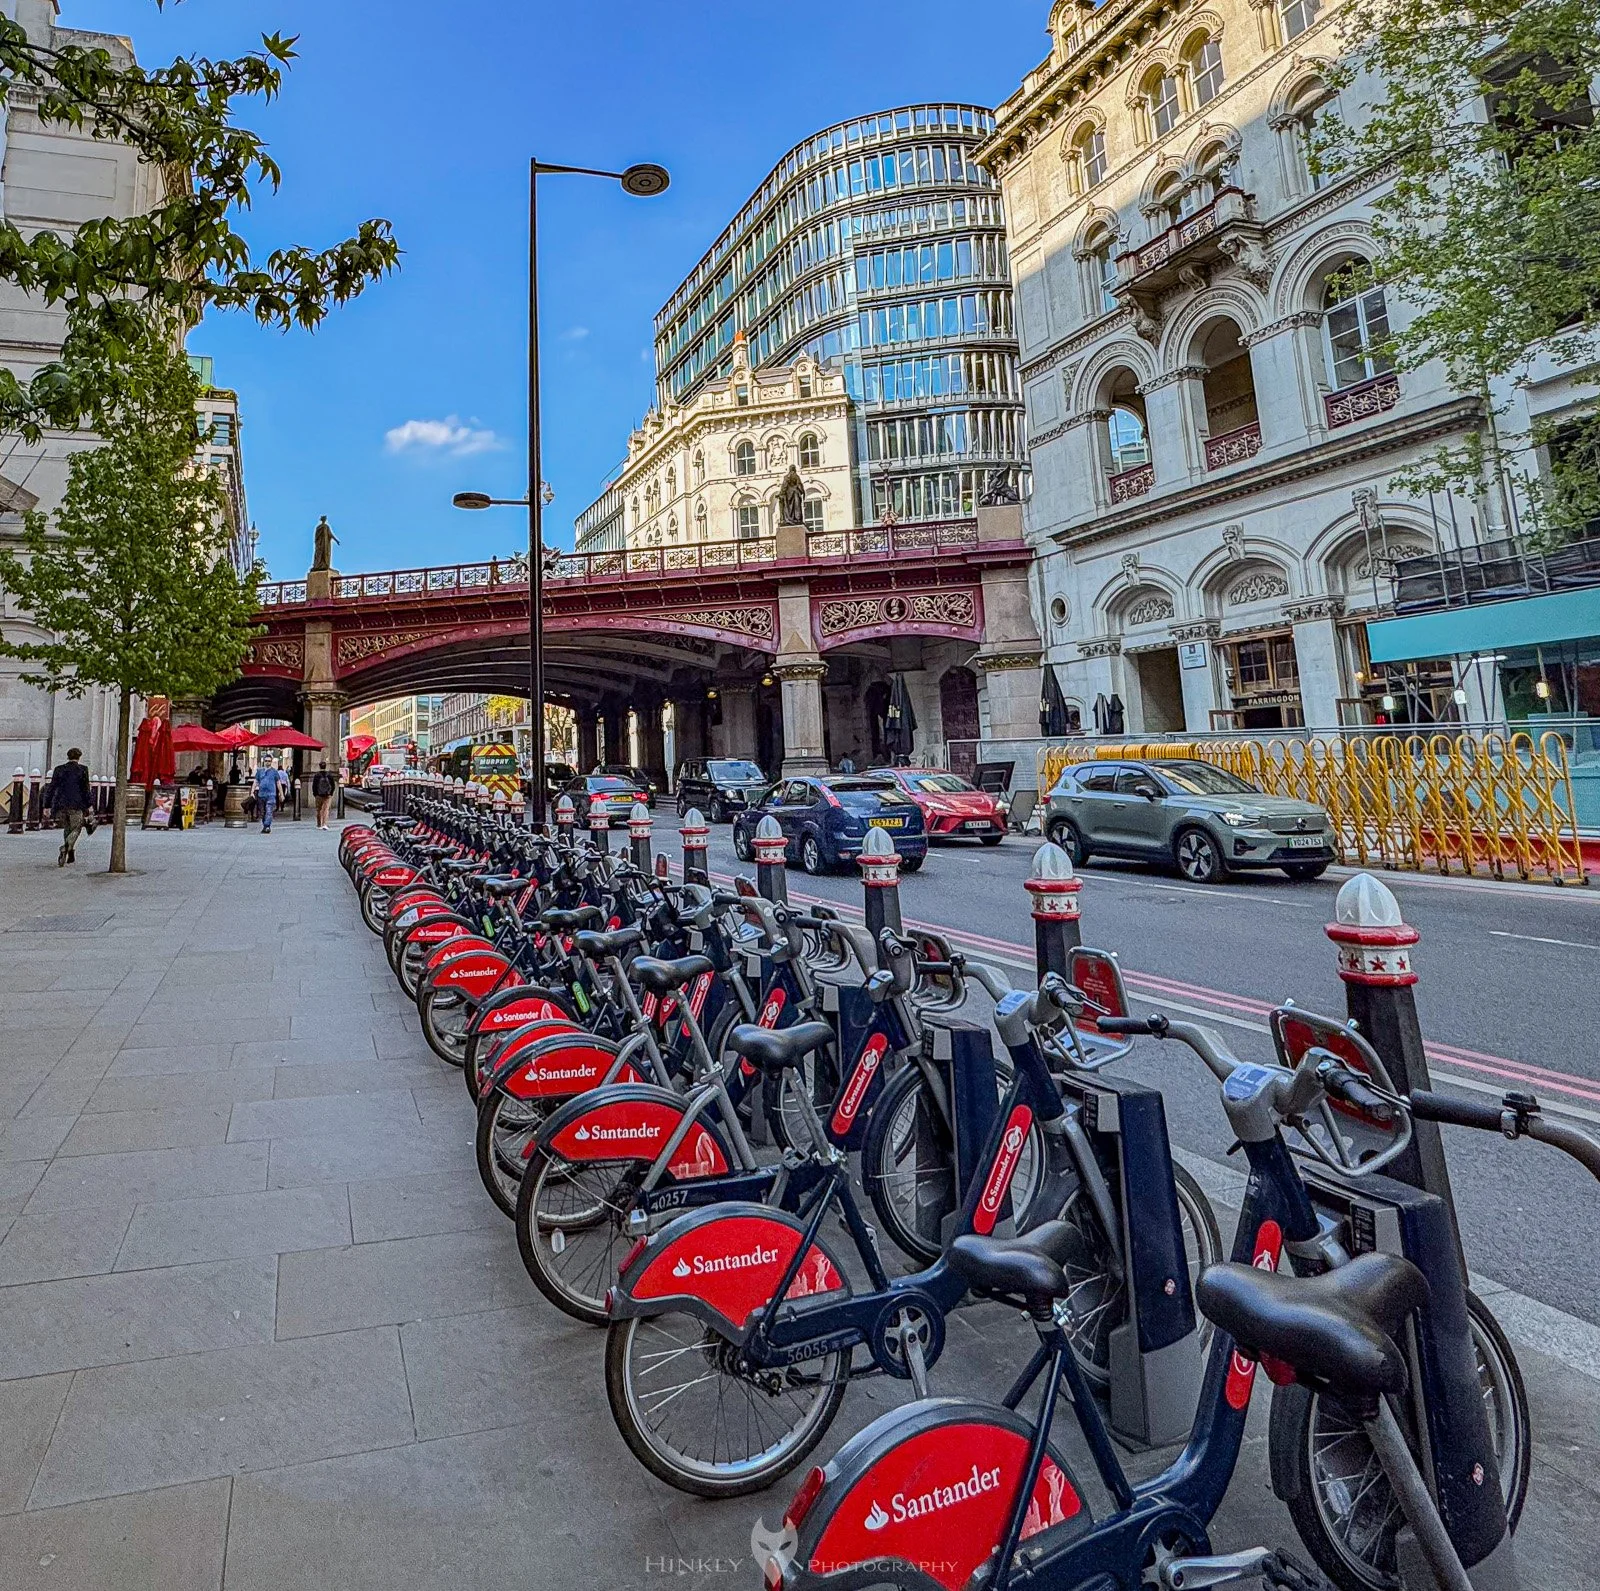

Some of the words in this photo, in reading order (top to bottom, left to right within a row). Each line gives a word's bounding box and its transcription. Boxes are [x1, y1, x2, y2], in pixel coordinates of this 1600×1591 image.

[1248, 694, 1300, 706] FARRINGDON
[459, 966, 498, 978] Santander
[503, 1011, 539, 1022] Santander
[538, 1065, 597, 1081] Santander
[847, 1071, 868, 1106] Santander
[591, 1123, 661, 1140] Santander
[989, 1154, 1011, 1197] Santander
[651, 1190, 689, 1211] 40257
[693, 1246, 779, 1275] Santander
[787, 1339, 828, 1364] 56055
[891, 1464, 1001, 1523] Santander
